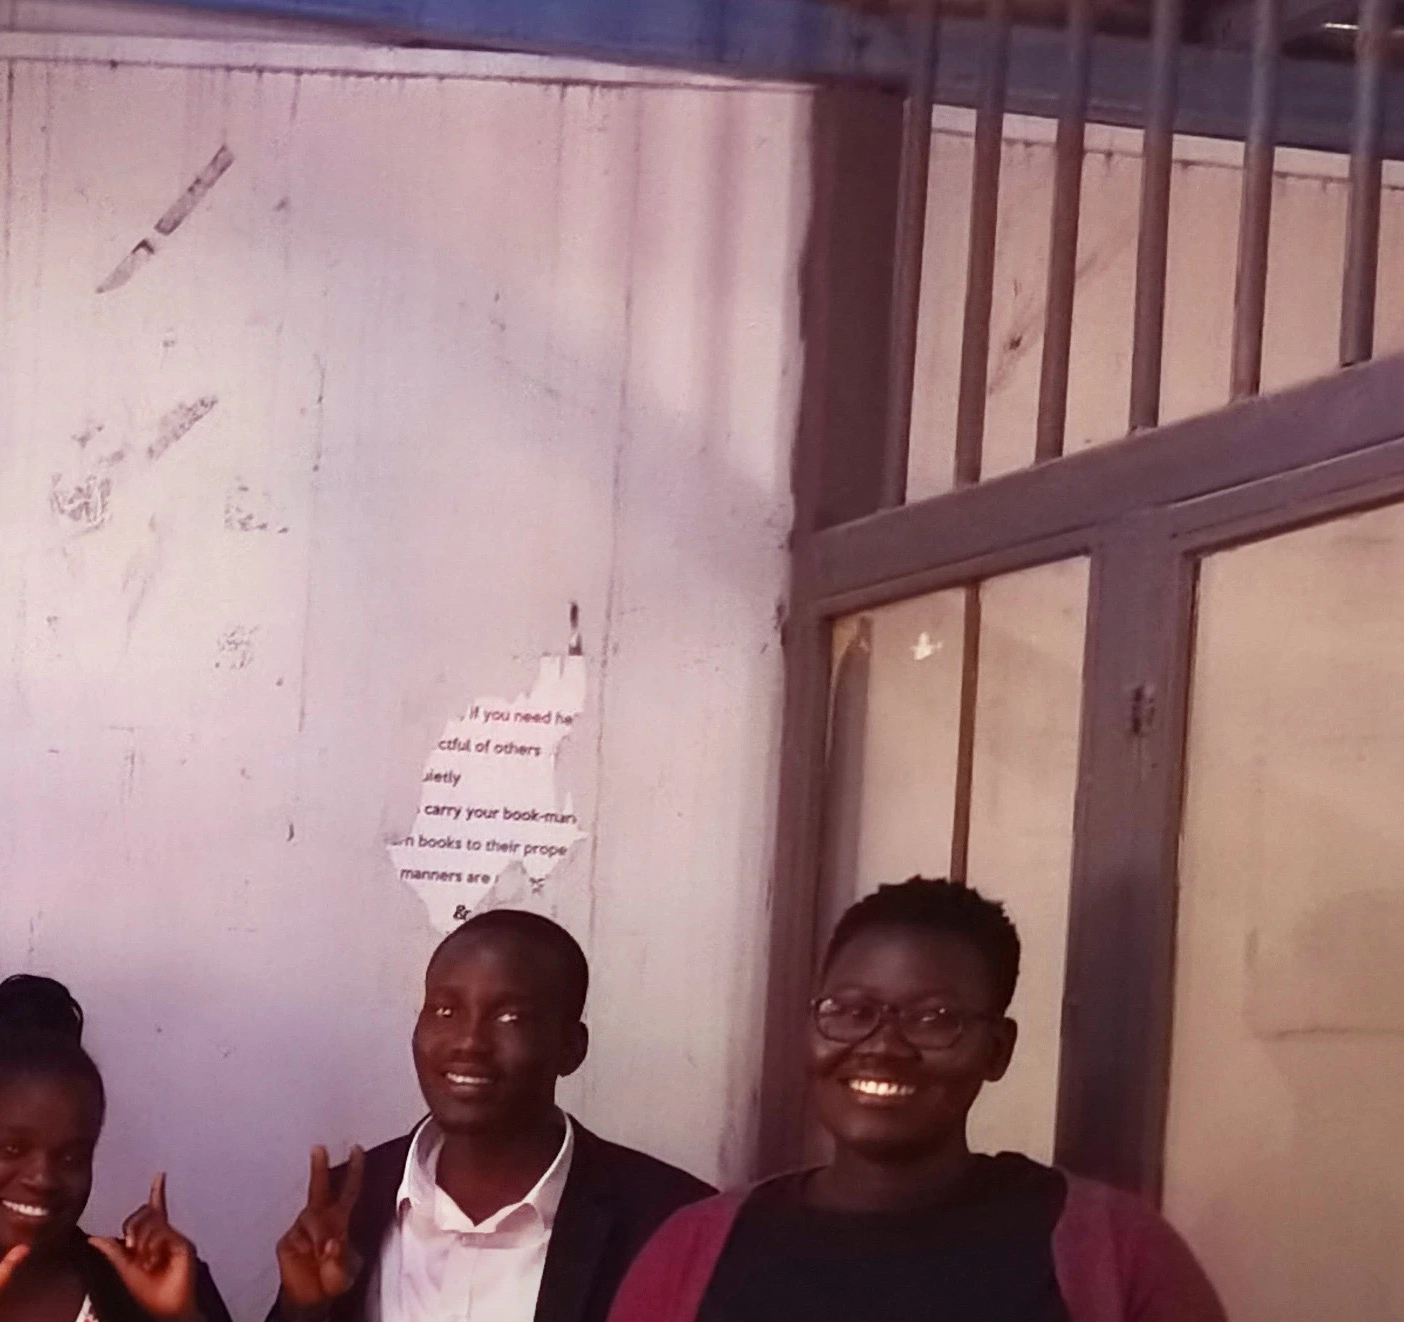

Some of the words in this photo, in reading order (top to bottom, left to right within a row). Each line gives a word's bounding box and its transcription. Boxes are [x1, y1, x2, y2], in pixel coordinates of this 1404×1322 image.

[483, 710, 510, 724] you
[514, 711, 552, 725] need
[555, 711, 576, 726] he
[475, 740, 491, 754] of
[494, 742, 542, 757] others
[424, 803, 462, 820] carry
[466, 806, 500, 821] your
[418, 833, 462, 850] books
[466, 839, 481, 851] to
[485, 839, 520, 854] their
[399, 867, 463, 883] manners
[466, 873, 491, 884] are
